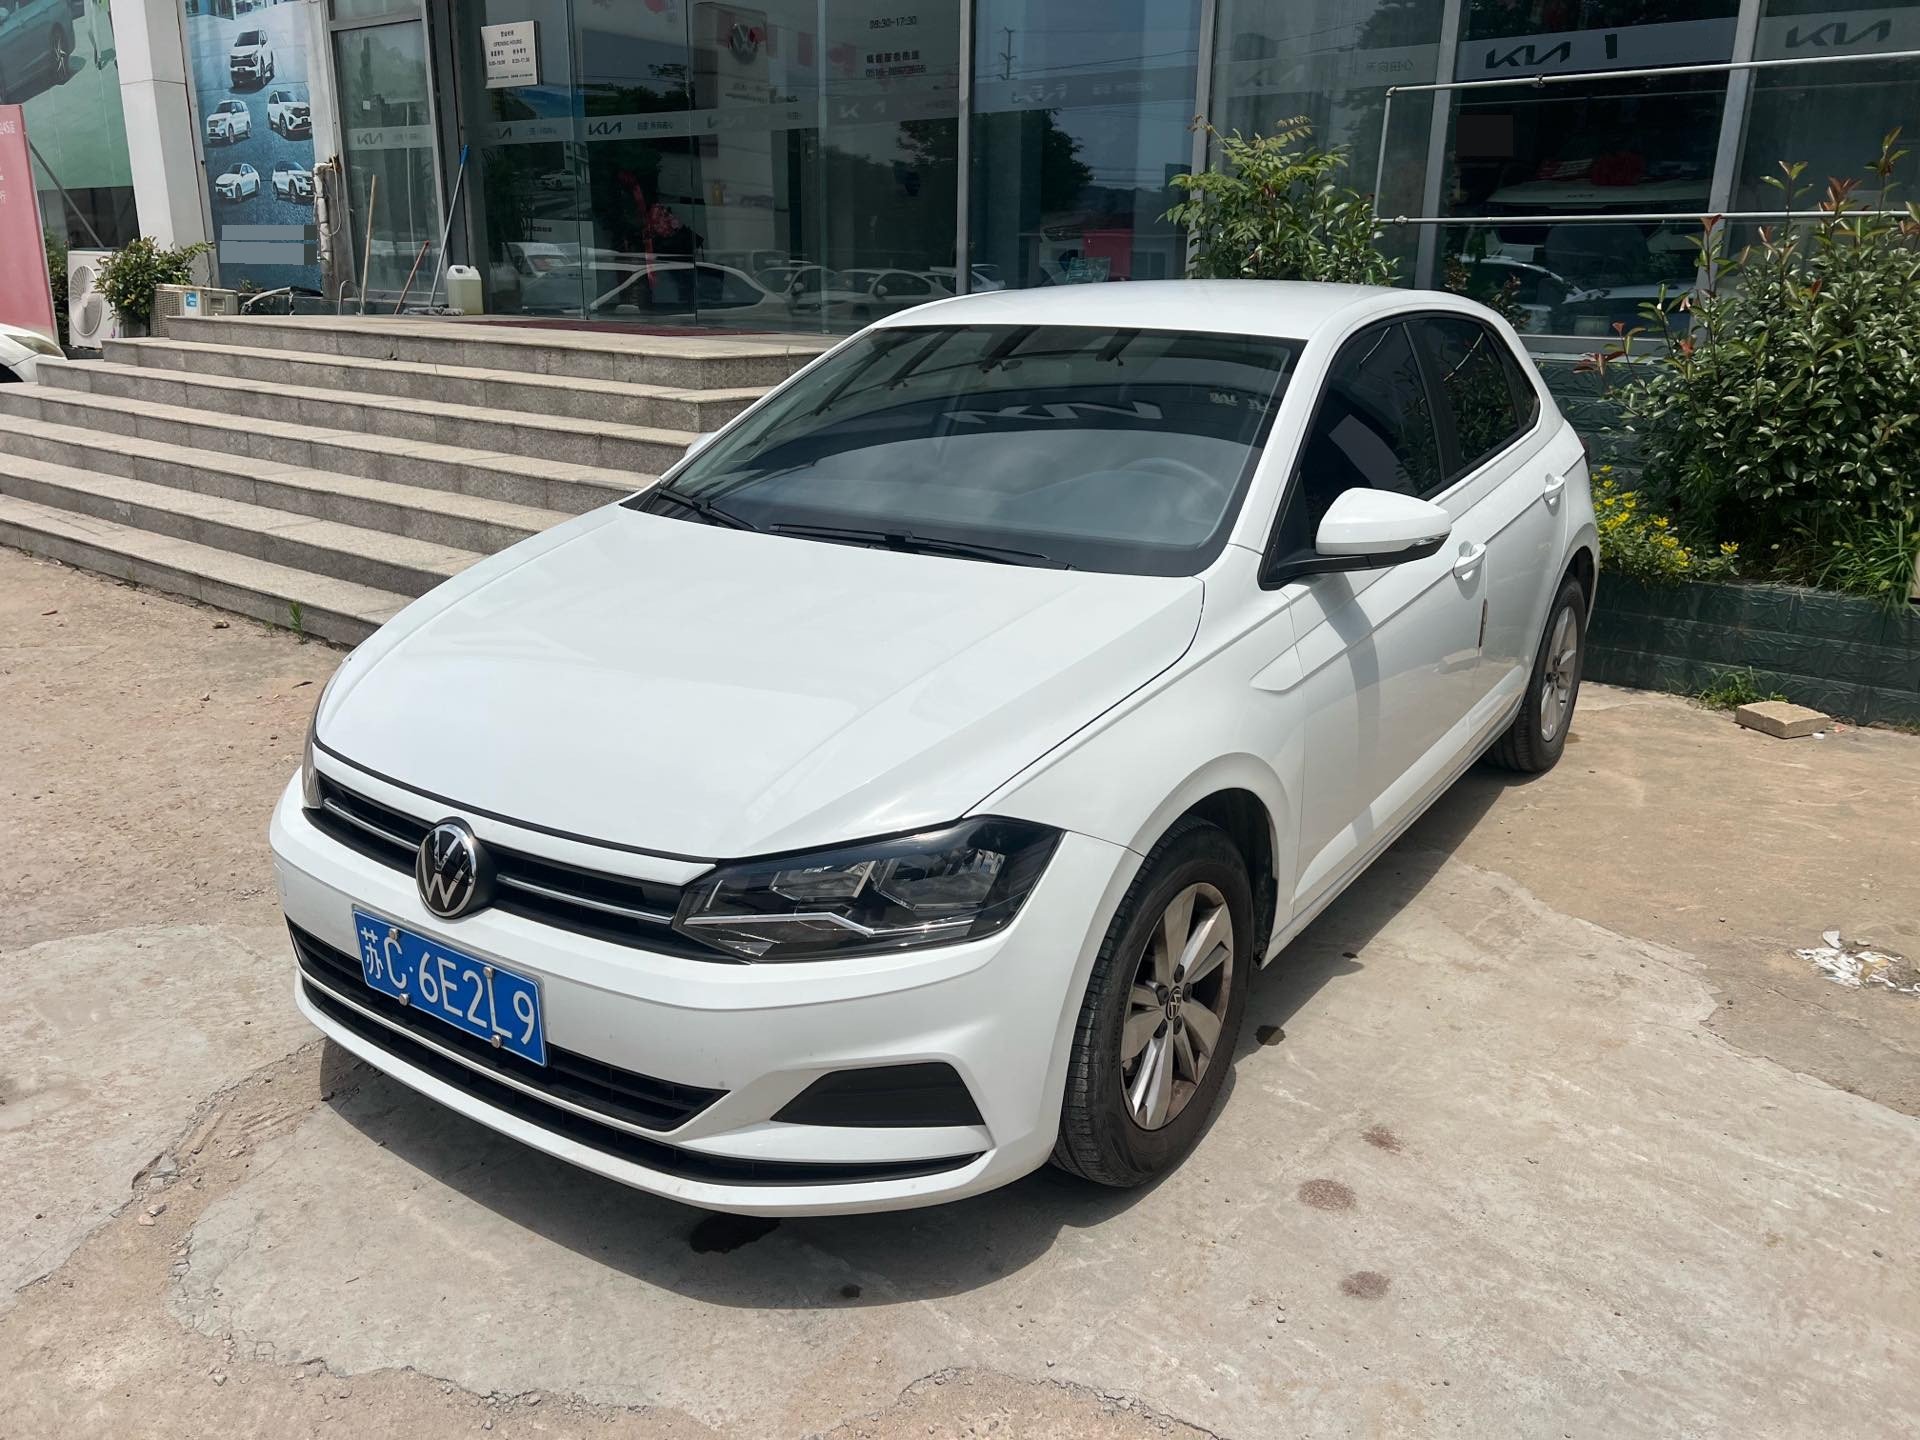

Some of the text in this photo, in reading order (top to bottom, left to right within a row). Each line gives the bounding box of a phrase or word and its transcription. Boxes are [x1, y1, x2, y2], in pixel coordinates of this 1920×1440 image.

[1785, 18, 1892, 48] KIA
[1485, 41, 1571, 69] KIA
[357, 131, 383, 145] KIA
[588, 120, 622, 136] KIA
